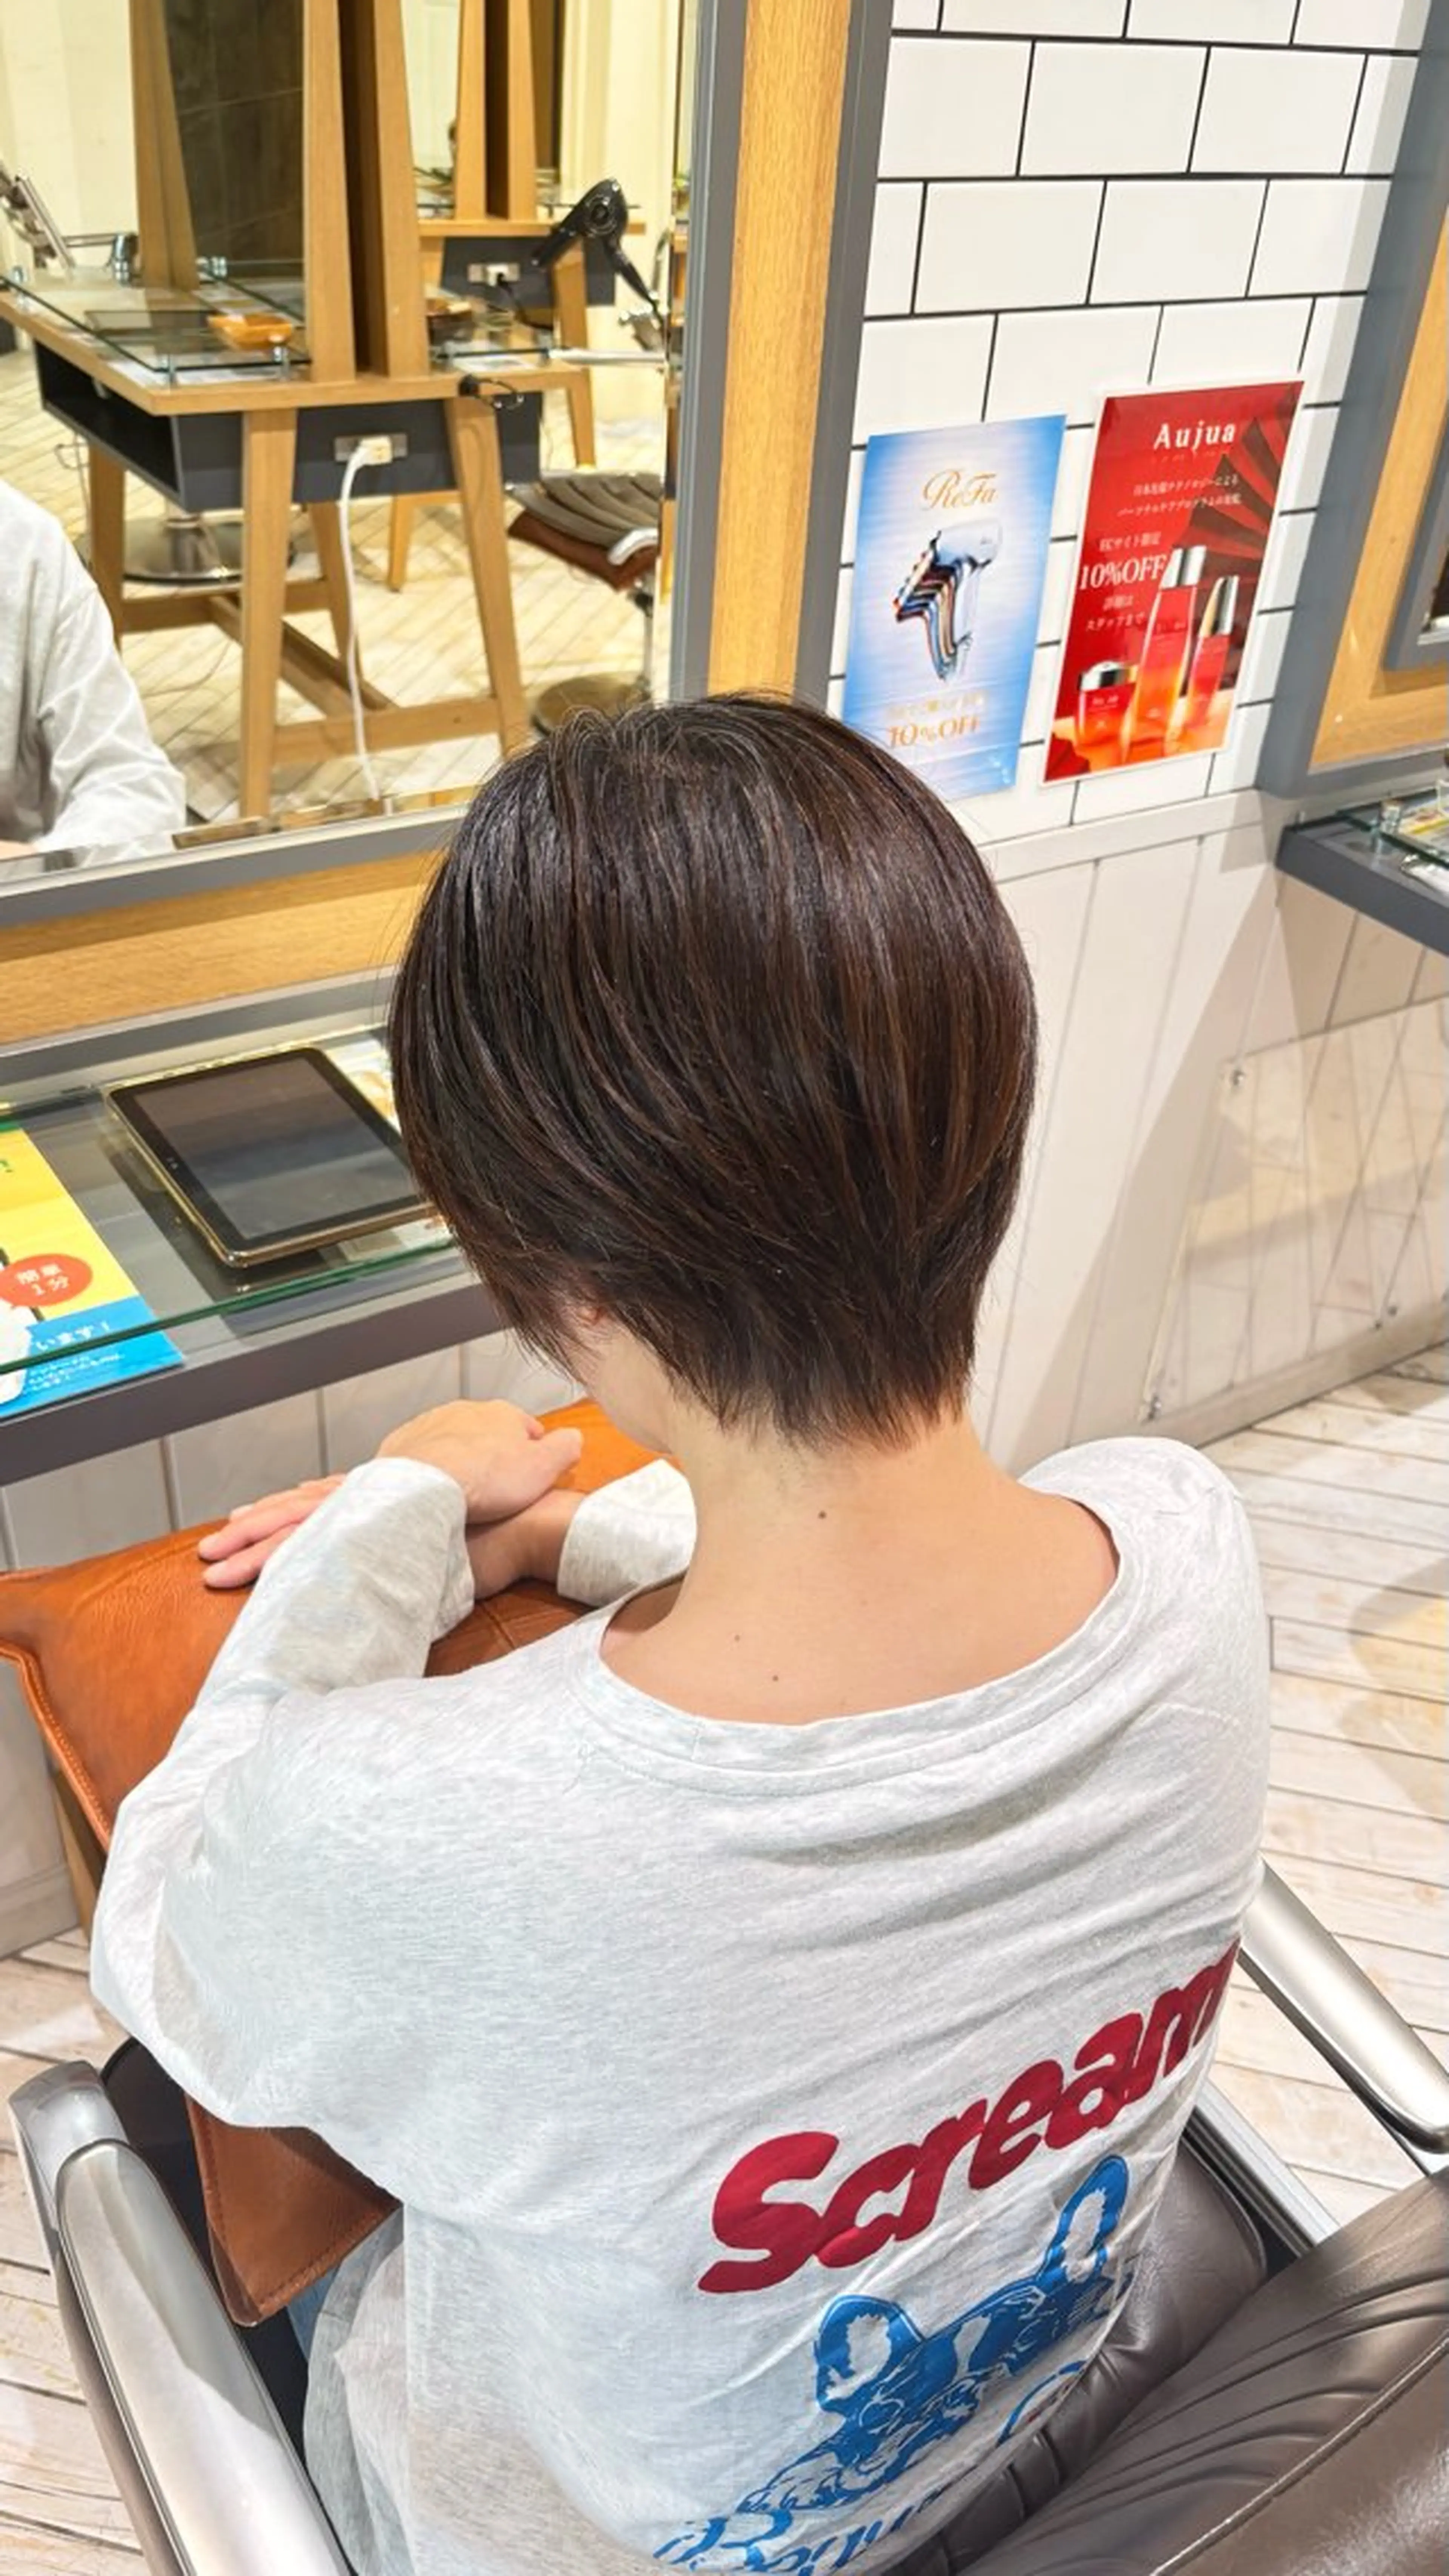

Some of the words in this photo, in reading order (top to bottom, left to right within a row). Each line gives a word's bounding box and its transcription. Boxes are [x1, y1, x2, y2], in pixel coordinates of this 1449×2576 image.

[1153, 420, 1236, 454] Aujua
[922, 469, 997, 510] ReFa
[1079, 554, 1167, 590] 10%OFF
